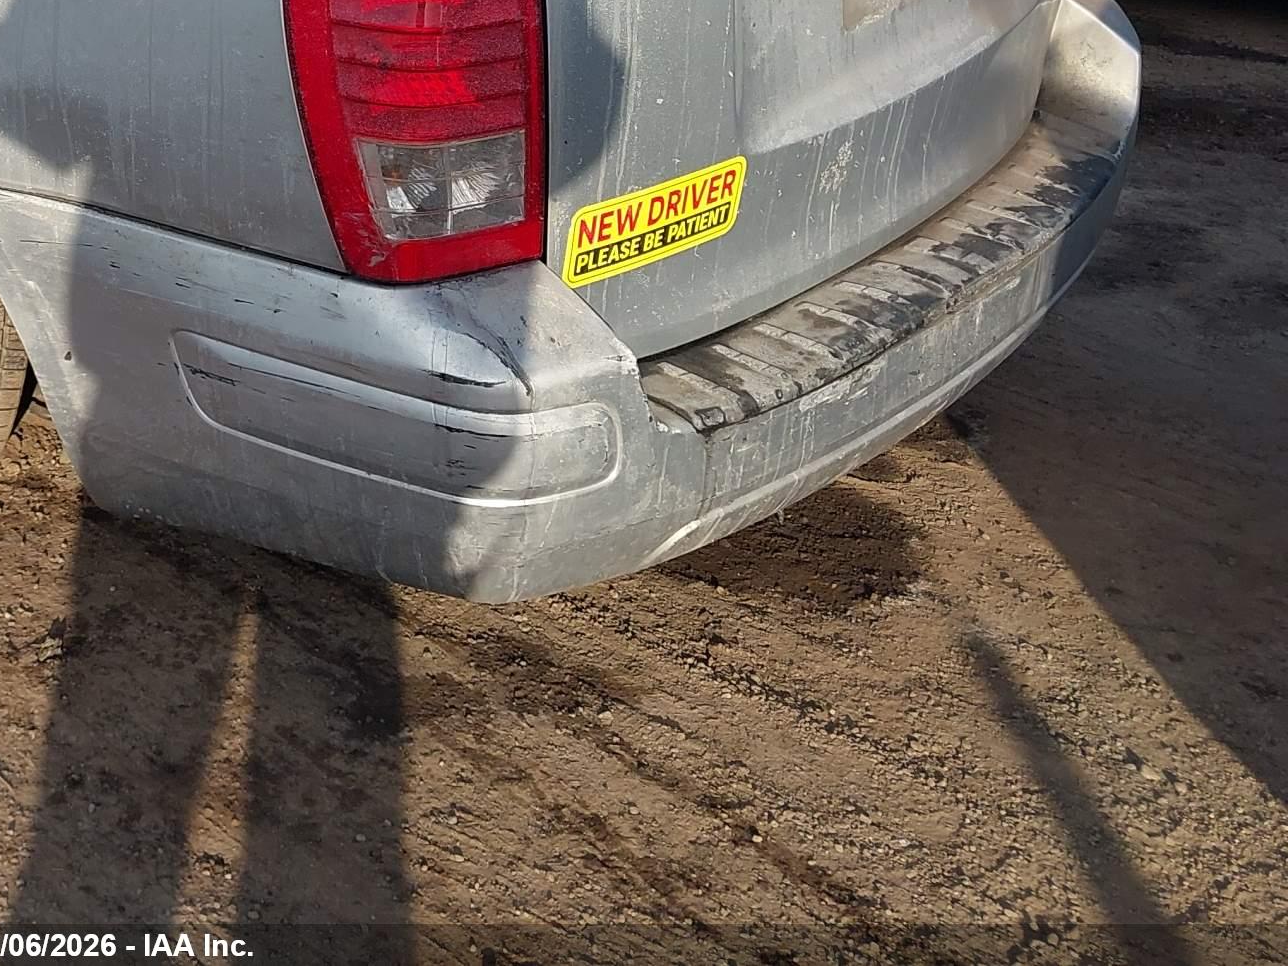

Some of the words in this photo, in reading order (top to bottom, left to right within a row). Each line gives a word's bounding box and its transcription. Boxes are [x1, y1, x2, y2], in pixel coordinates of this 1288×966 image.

[575, 237, 642, 274] PLEASE
[643, 227, 665, 252] BE
[666, 204, 730, 243] PATIENT
[577, 201, 643, 248] NEW
[647, 169, 737, 227] DRIVER
